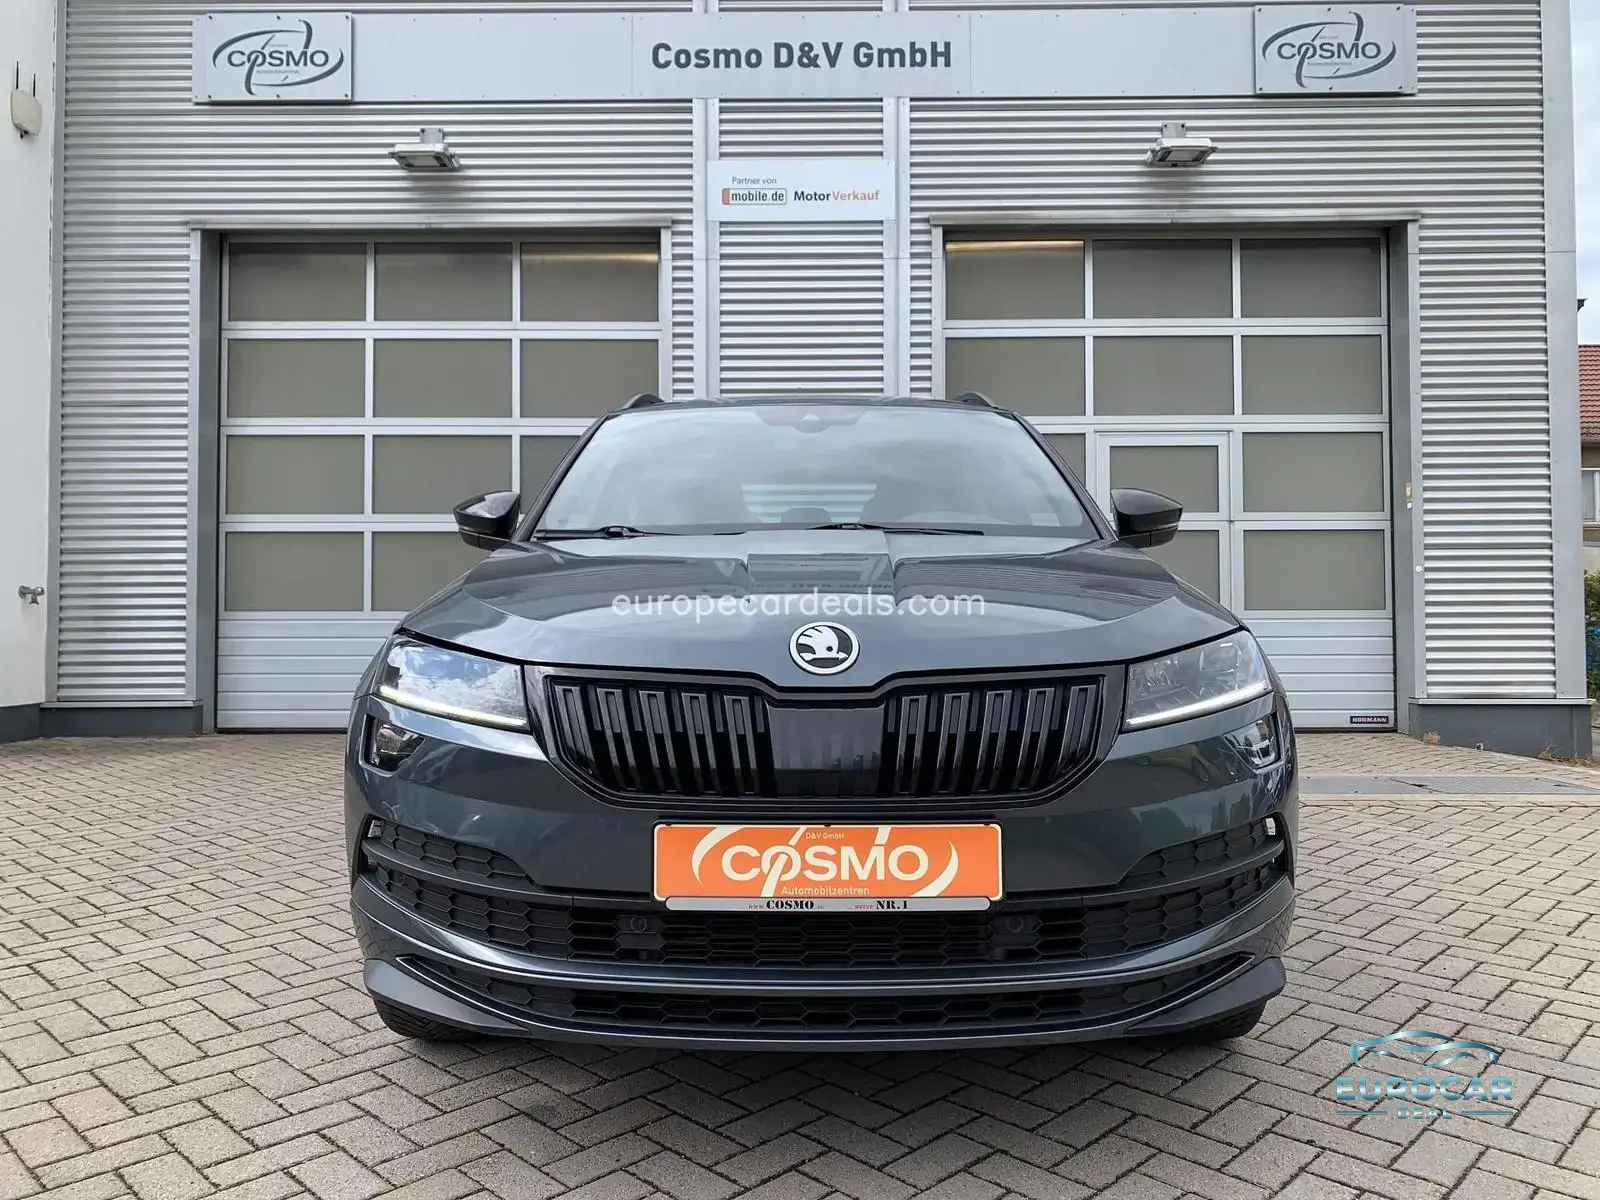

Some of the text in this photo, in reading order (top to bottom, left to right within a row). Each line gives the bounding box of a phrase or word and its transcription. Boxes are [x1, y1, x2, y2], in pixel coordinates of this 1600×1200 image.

[227, 50, 329, 68] COSMO
[651, 41, 952, 69] Cosmo D&V GmbH
[1277, 42, 1382, 60] COSMO
[731, 176, 761, 185] Partner
[805, 832, 845, 840] D&V GmbH
[721, 844, 930, 882] COSMO
[781, 885, 870, 896] Automobilzentren
